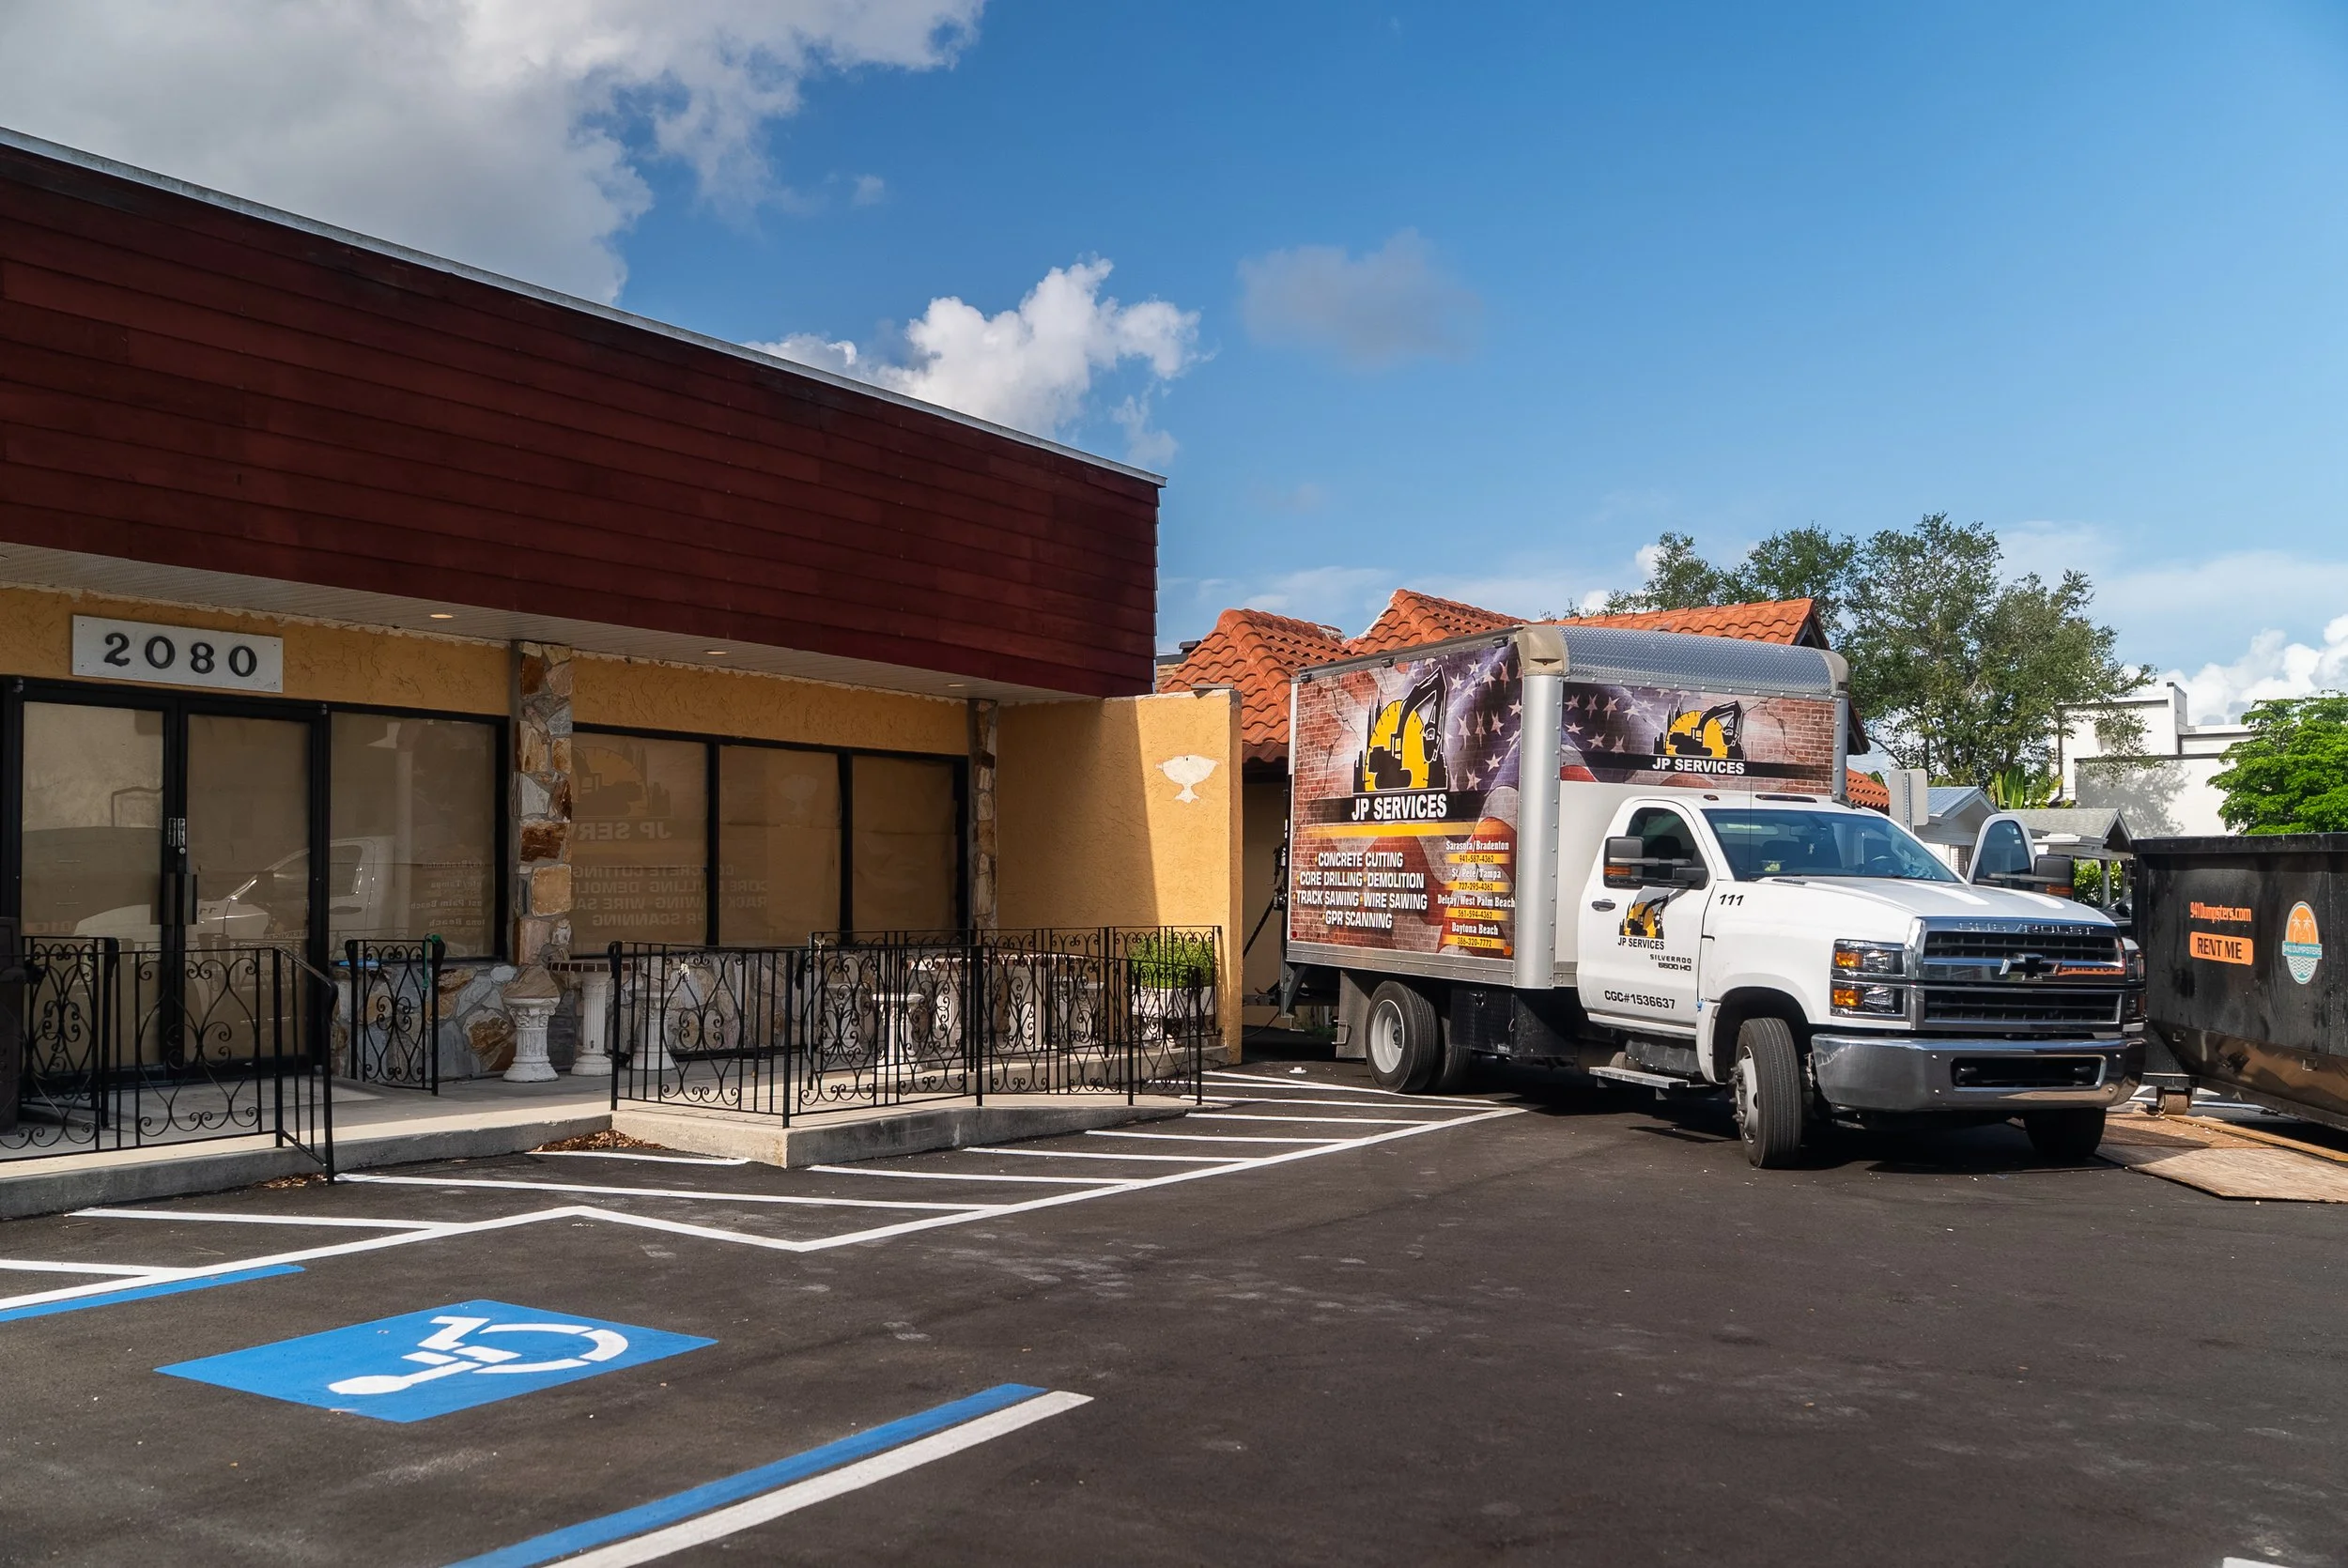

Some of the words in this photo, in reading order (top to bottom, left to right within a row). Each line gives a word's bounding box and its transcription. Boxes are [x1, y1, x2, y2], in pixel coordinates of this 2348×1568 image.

[103, 632, 257, 677] 2080
[1652, 757, 1671, 770] JP
[1675, 759, 1745, 775] SERVICES
[1352, 797, 1370, 821] JP
[1373, 793, 1447, 821] SERVICES
[1318, 852, 1363, 868] CONCRETE
[1365, 852, 1404, 868] CUTTING
[1299, 871, 1322, 885] CORE
[1323, 871, 1363, 887] DRILLING
[1367, 872, 1425, 889] DEMOLITION
[1462, 869, 1502, 881] Pete/Tampa
[1296, 890, 1323, 904] TRACK
[1324, 890, 1359, 907] SAWING
[1364, 892, 1387, 908] WIRE
[1389, 893, 1428, 910] SAWING
[1476, 896, 1493, 907] Palm
[1494, 897, 1516, 908] Beach
[1720, 894, 1744, 906] 111
[1325, 910, 1343, 926] GPR
[1345, 911, 1392, 929] SCANNING
[2189, 901, 2251, 924] 941Dumpsters.com
[1451, 922, 1477, 934] Daytona
[1478, 924, 1499, 935] Beach
[1617, 937, 1627, 946] JP
[1629, 938, 1665, 950] SERVICES
[2197, 937, 2222, 957] RENT
[2225, 941, 2242, 960] ME
[1649, 953, 1691, 963] SILVERADO
[1604, 990, 1676, 1009] CGC#1536637
